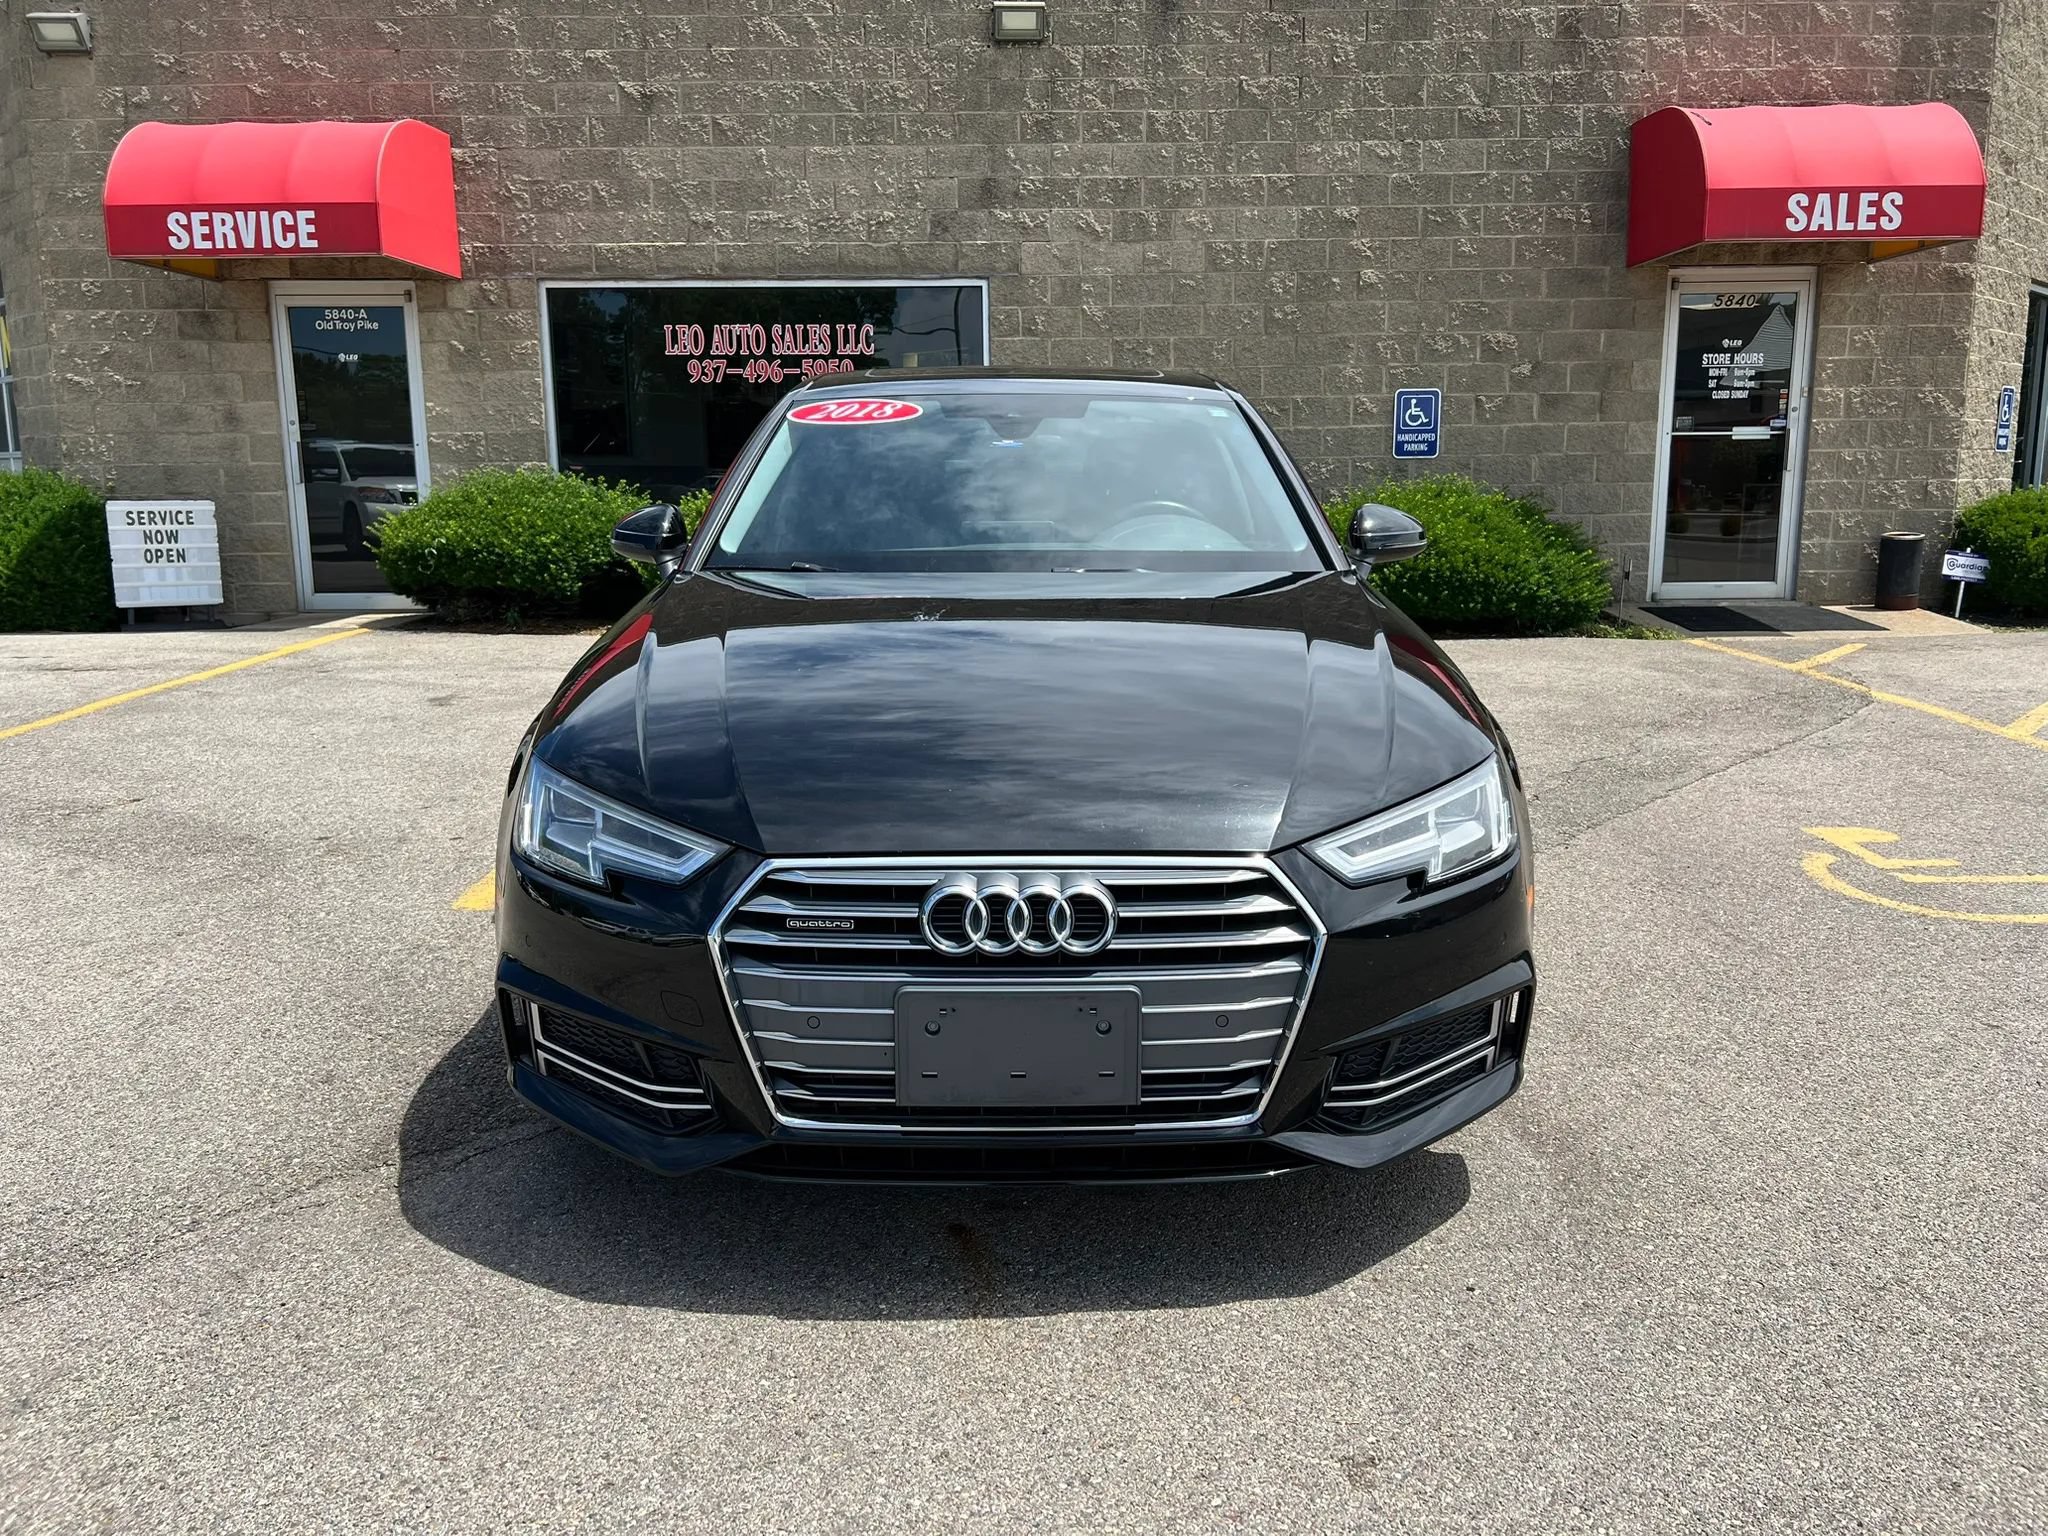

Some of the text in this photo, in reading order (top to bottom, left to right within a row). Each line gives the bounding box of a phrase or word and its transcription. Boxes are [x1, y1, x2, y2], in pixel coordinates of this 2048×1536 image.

[1785, 191, 1904, 232] SALES
[166, 210, 319, 250] SERVICE
[324, 309, 368, 320] 5840-A
[315, 320, 379, 332] Old Troy Pike
[664, 324, 875, 356] LEO AUTO SALES LLC
[1702, 353, 1764, 365] STORE HOURS
[1711, 390, 1749, 399] CLOSED SUNDAY
[804, 402, 903, 420] 2018
[1397, 433, 1436, 442] HANDICAPPED
[1403, 443, 1428, 451] PARKING
[125, 510, 195, 526] SERVICE
[143, 529, 179, 545] NOW
[143, 548, 187, 563] OPEN
[789, 920, 851, 928] quattro
